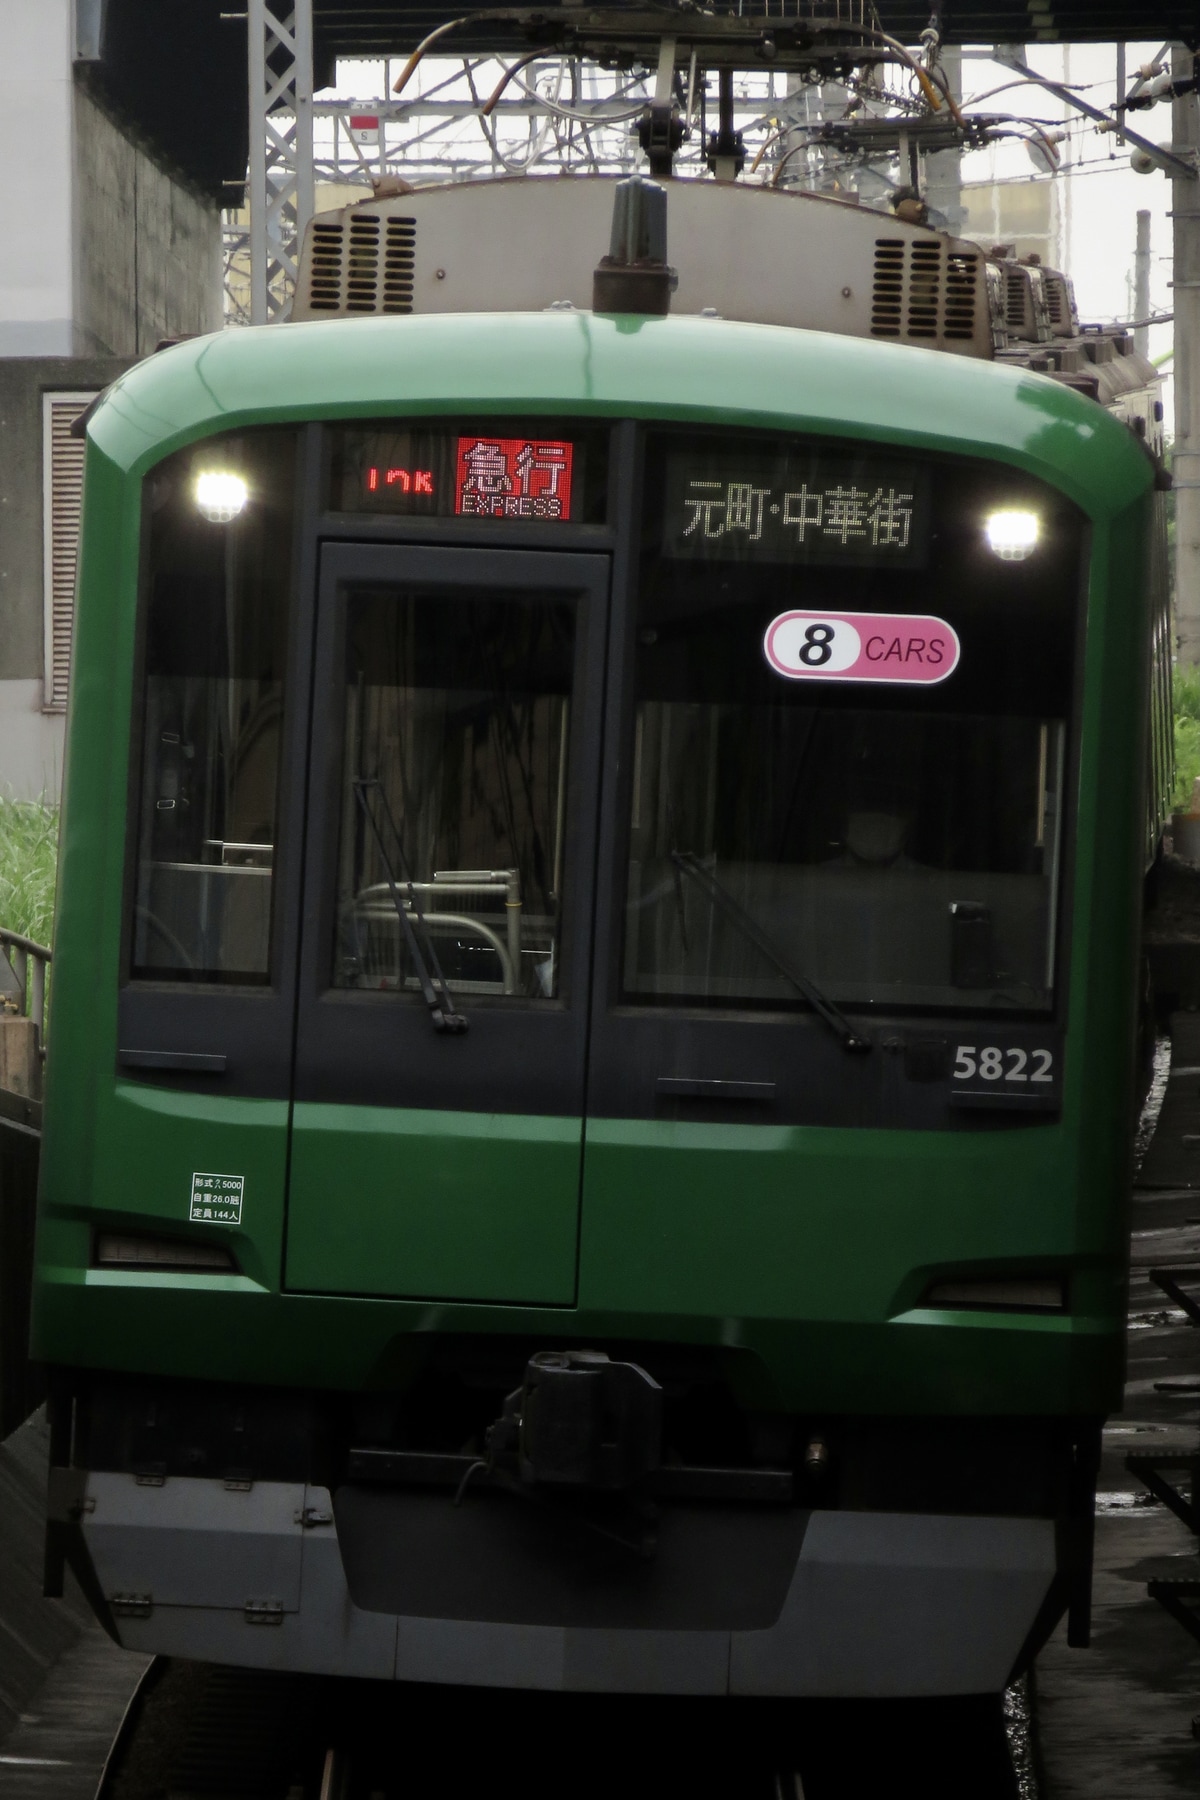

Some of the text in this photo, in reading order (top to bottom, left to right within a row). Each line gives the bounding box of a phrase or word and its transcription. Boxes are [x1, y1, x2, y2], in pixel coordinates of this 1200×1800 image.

[463, 442, 565, 495] 急行
[462, 494, 561, 517] EXPRESS
[799, 623, 945, 666] 8 CARS
[953, 1045, 1053, 1082] 5822
